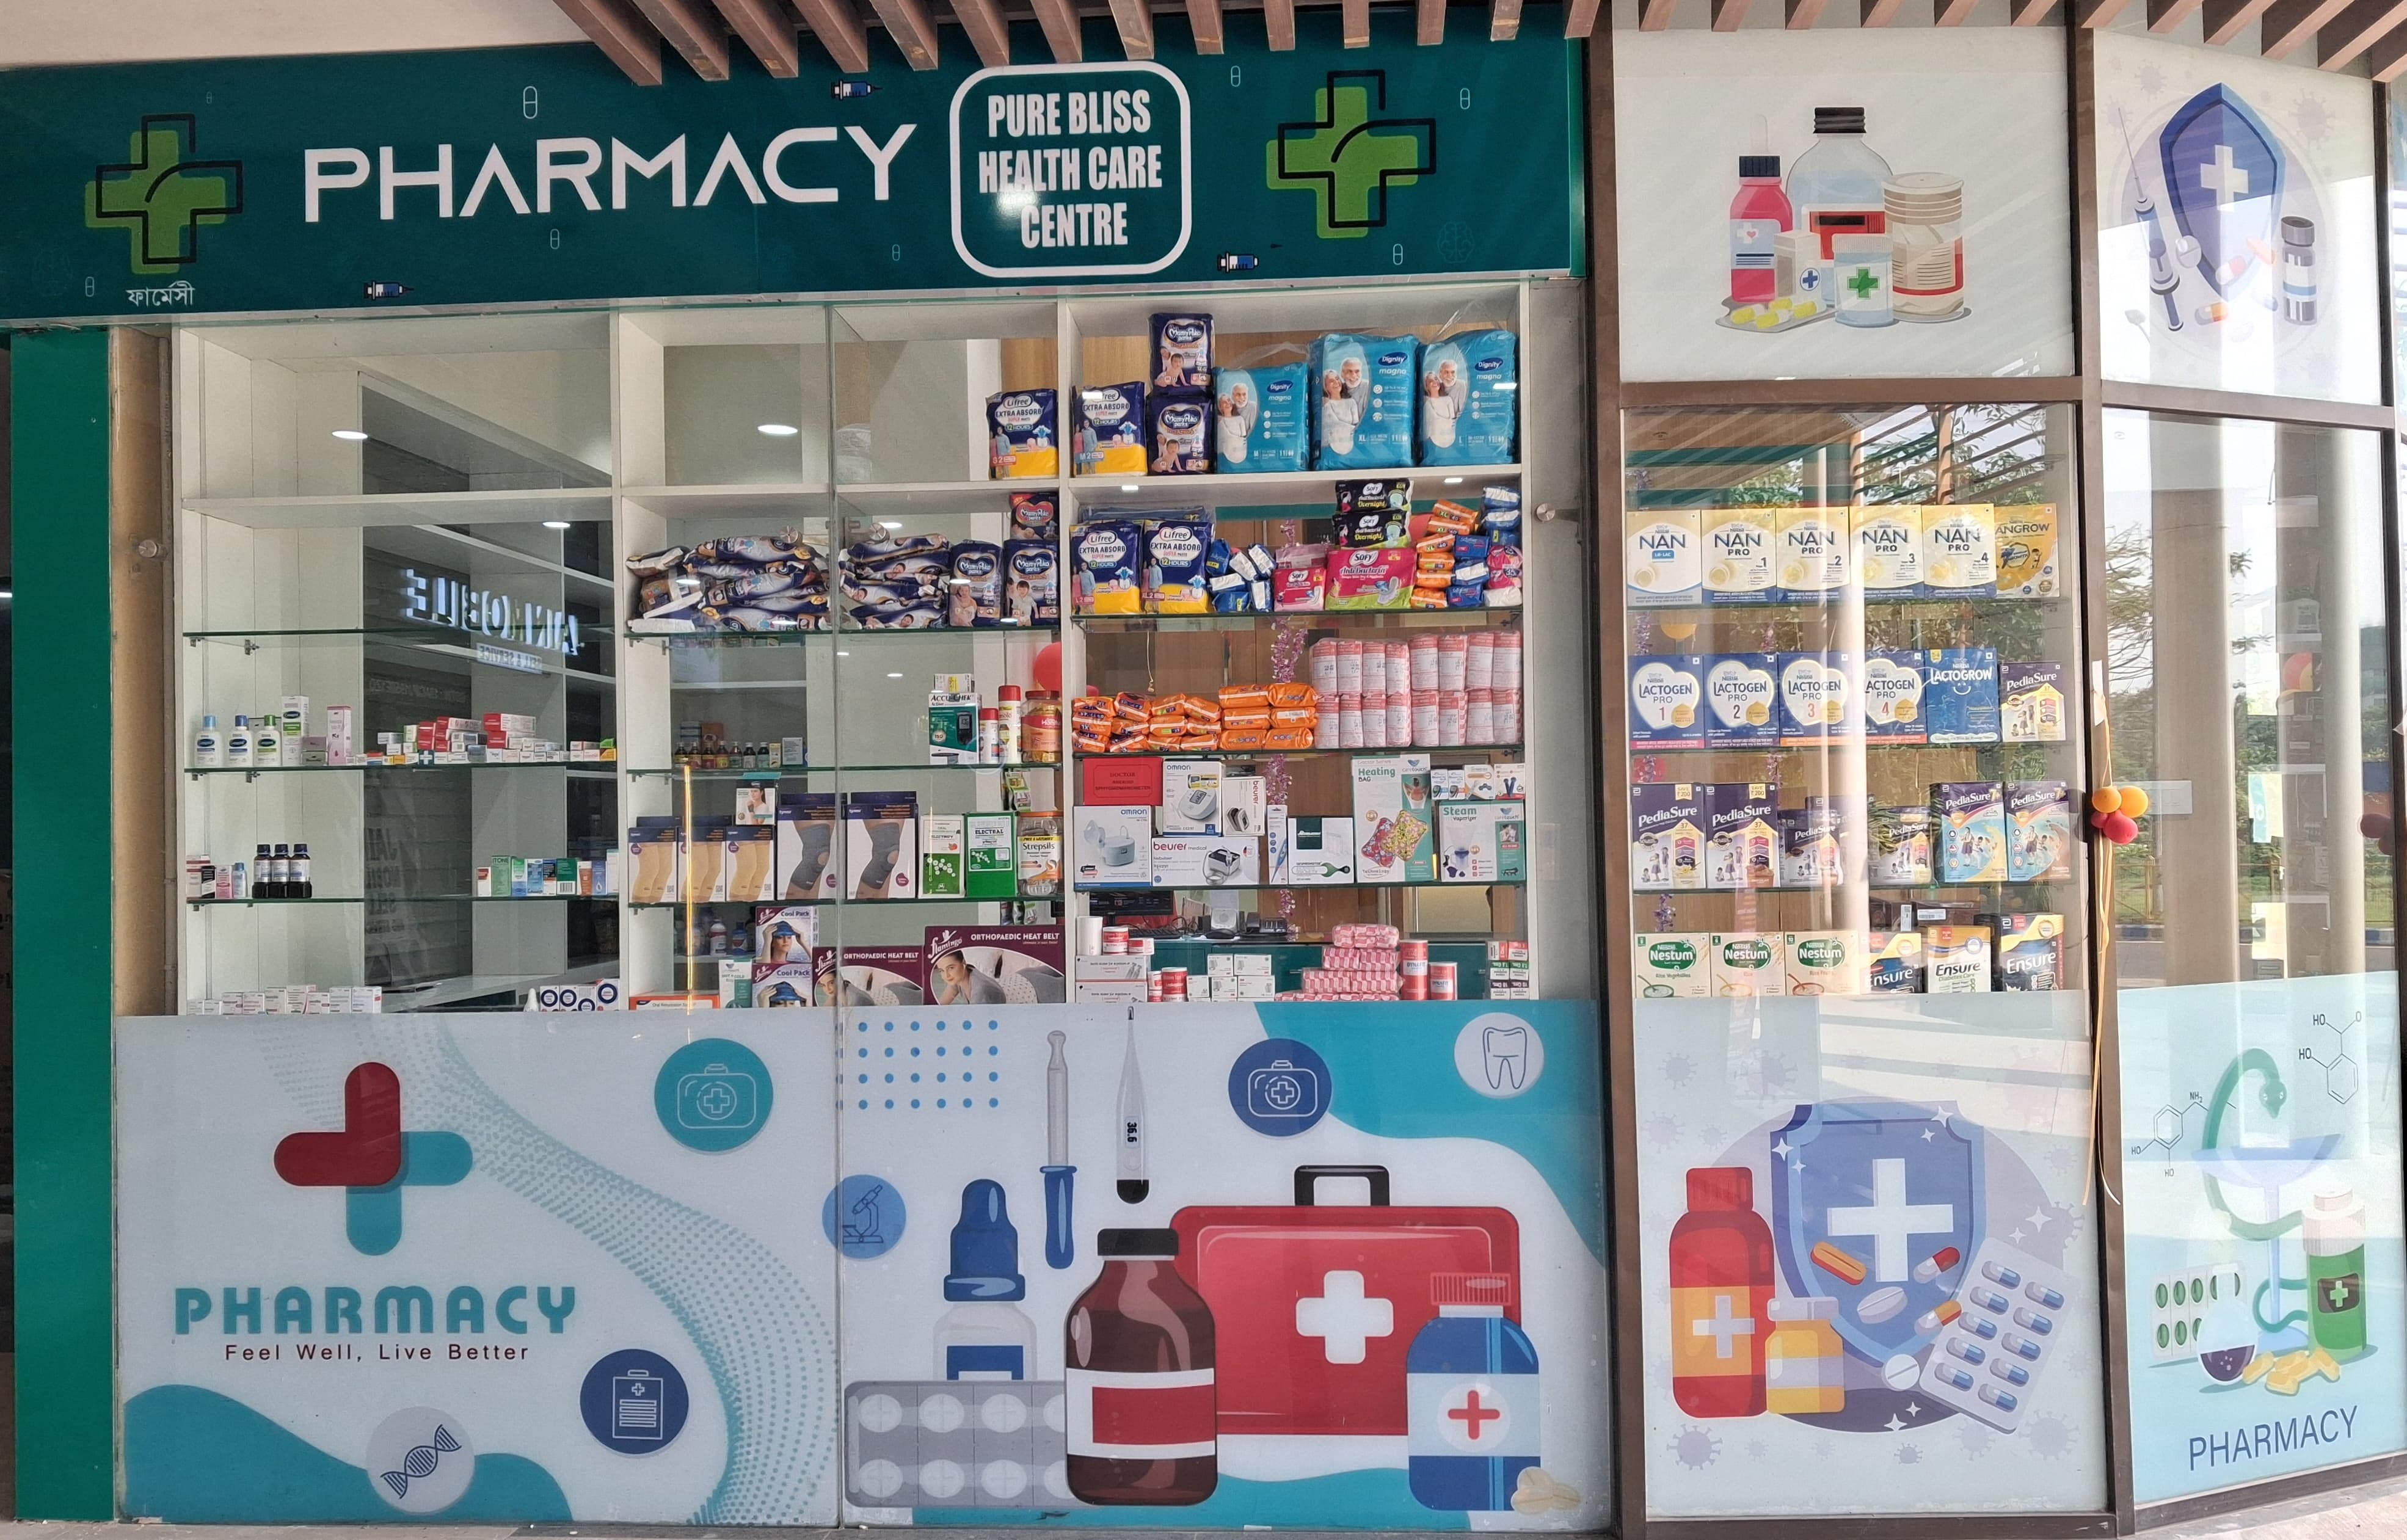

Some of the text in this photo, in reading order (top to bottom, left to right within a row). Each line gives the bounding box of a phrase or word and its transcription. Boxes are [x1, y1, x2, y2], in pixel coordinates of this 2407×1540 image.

[987, 89, 1151, 138] PURE BLISS
[304, 123, 917, 223] PHARMACY
[978, 143, 1163, 193] HEALTH CARE
[1020, 202, 1129, 249] CENTRE
[1382, 355, 1407, 365] Dignity
[1378, 368, 1407, 376] magna
[1007, 398, 1029, 407] Lifree
[995, 408, 1043, 418] EXTRA ABSORB
[1440, 510, 1448, 518] XL
[1162, 529, 1189, 540] Lifree
[1934, 527, 1981, 543] NAN
[1995, 522, 2050, 535] ANGROW
[1090, 534, 1113, 543] Lifree
[1639, 534, 1687, 550] NAN
[1714, 532, 1762, 548] NAN
[1788, 531, 1835, 547] NAN
[1862, 529, 1909, 545] NAN
[1760, 557, 1767, 568] 1
[1834, 556, 1842, 566] 2
[1909, 553, 1915, 564] 3
[1981, 553, 1989, 563] 4
[1930, 667, 1993, 685] LACTOGROW
[2006, 672, 2058, 692] PediaSure
[1639, 681, 1693, 699] LACTOGEN
[1713, 680, 1767, 697] LACTOGEN
[1788, 680, 1841, 695] LACTOGEN
[1653, 696, 1673, 704] PRO
[1802, 692, 1823, 701] PRO
[1659, 706, 1665, 721] 1
[1733, 704, 1741, 719] 2
[1807, 703, 1816, 718] 3
[1881, 702, 1890, 717] 4
[1358, 766, 1396, 779] Heating
[1945, 792, 1991, 810] PediaSure
[2010, 791, 2056, 809] PediaSure
[1443, 806, 1477, 816] Steam
[1638, 806, 1698, 828] PediaSure
[1712, 804, 1772, 827] PediaSure
[1794, 824, 1837, 841] PediaSure
[1888, 821, 1930, 838] PediaSure
[1022, 841, 1055, 851] Strepsils
[1153, 841, 1187, 851] beurer
[970, 932, 1021, 941] ORTHOPAEDIC
[928, 935, 963, 959] flamingo
[1725, 948, 1768, 961] Nestum
[1799, 947, 1843, 959] Nestum
[1650, 950, 1694, 961] Nestum
[1935, 962, 1981, 977] Ensure
[2006, 952, 2056, 975] Ensure
[1867, 968, 1914, 988] Ensure
[2312, 1014, 2326, 1026] HO
[2298, 1048, 2312, 1060] HO
[1127, 1122, 1137, 1142] 36.6
[2130, 1146, 2141, 1155] HO
[2164, 1168, 2174, 1177] HO
[174, 1285, 576, 1336] PHARMACY
[225, 1343, 530, 1363] Feel Well, Live Better
[2188, 1404, 2358, 1471] PHARMACY
